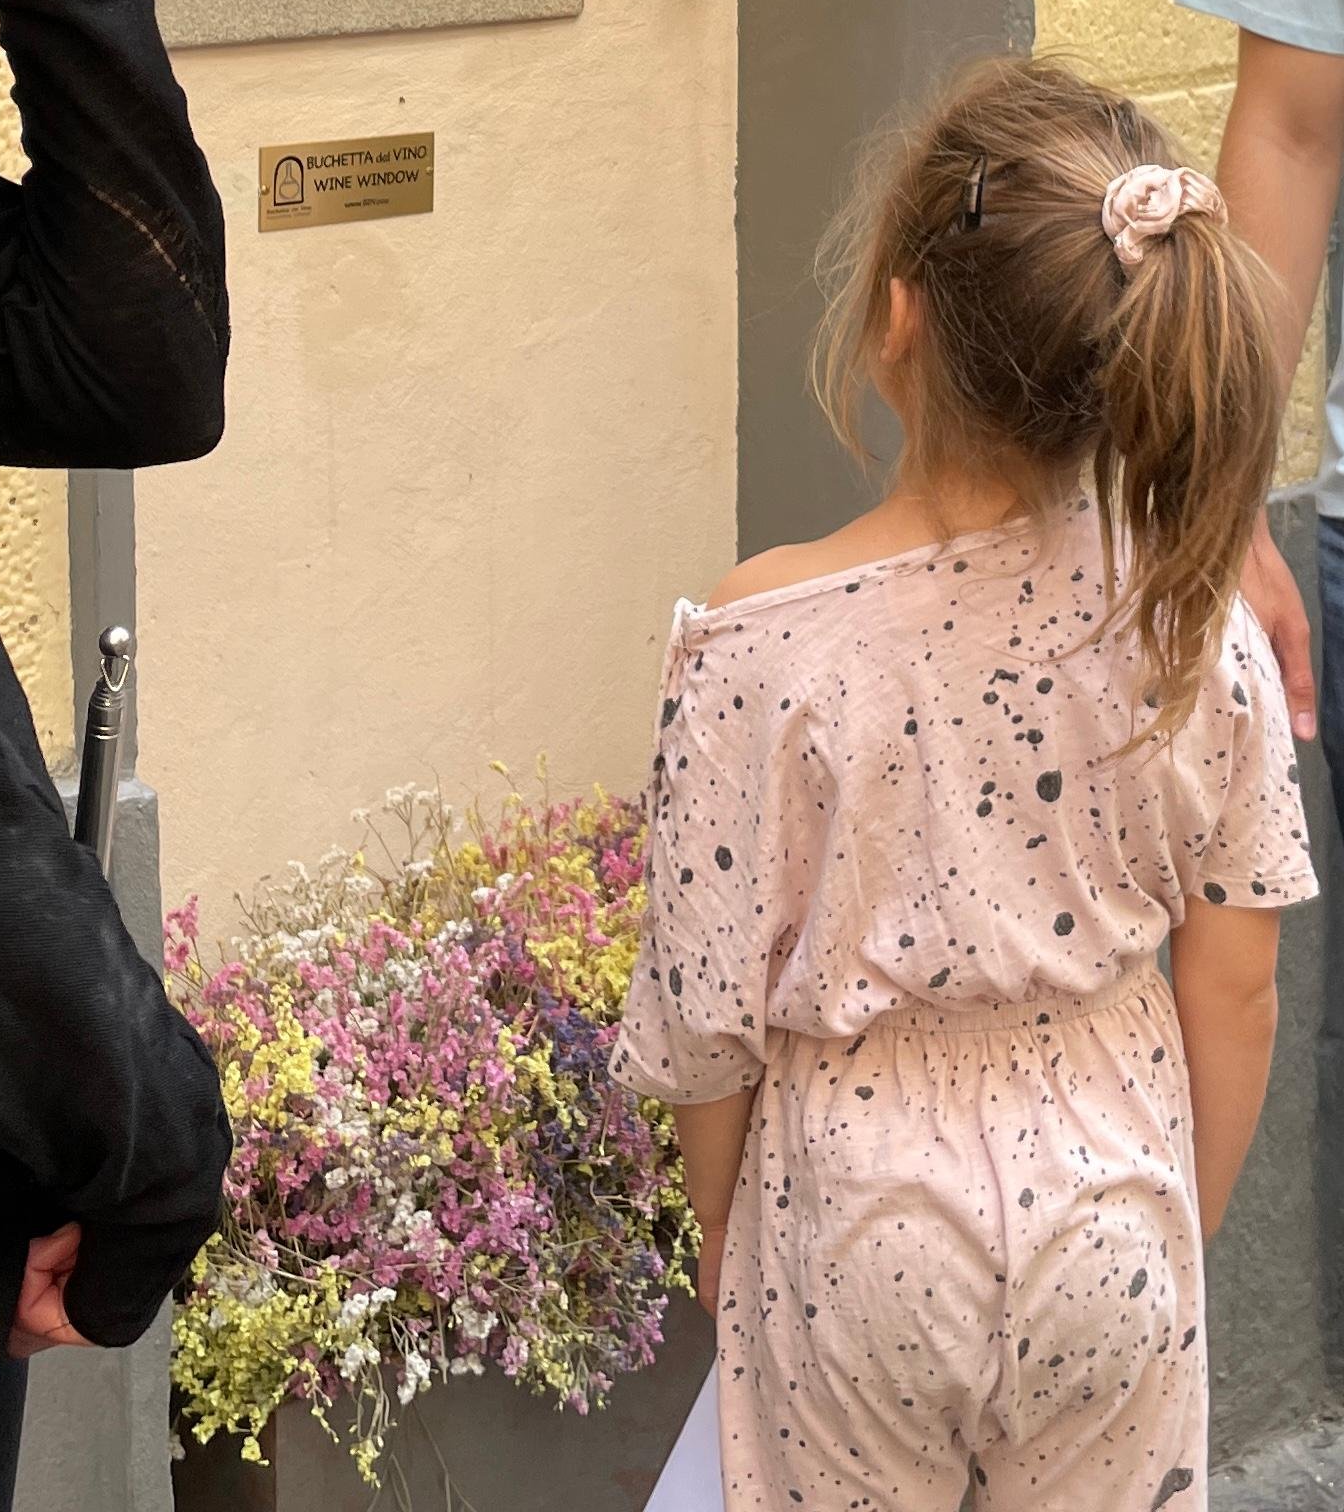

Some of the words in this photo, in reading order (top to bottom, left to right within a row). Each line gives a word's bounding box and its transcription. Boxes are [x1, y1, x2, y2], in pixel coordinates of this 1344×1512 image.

[306, 151, 373, 170] BUCHETTA
[393, 145, 427, 161] VINO
[314, 176, 353, 193] WINE
[357, 169, 419, 188] WINDOW
